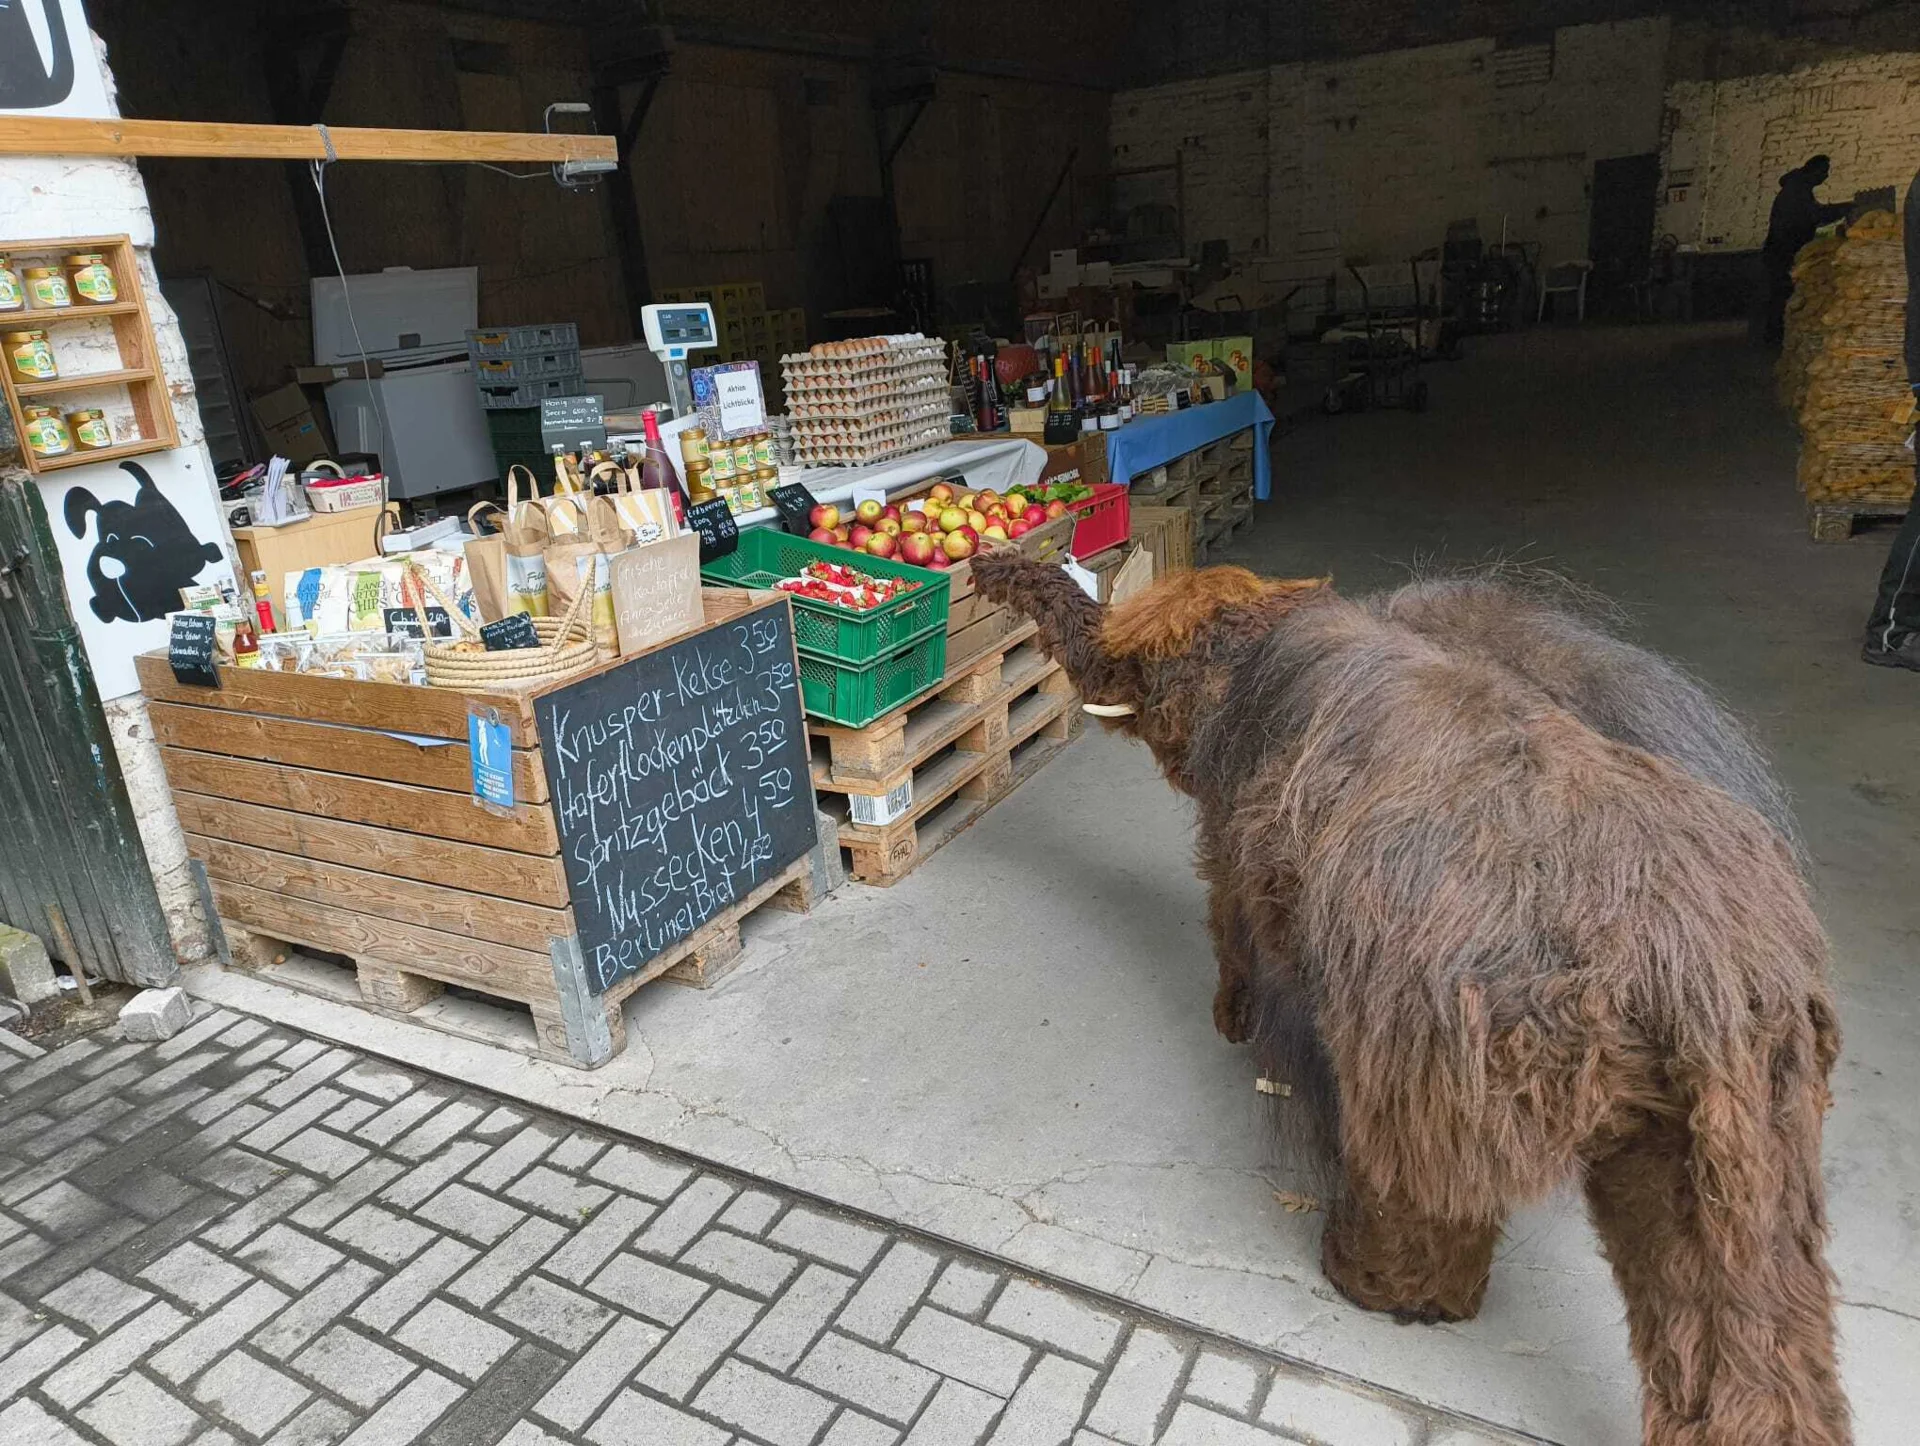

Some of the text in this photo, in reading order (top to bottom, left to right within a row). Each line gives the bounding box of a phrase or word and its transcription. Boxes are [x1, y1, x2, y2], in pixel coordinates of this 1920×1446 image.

[723, 398, 755, 409] Lichtblicke
[727, 385, 746, 393] Aktion
[553, 646, 736, 779] Knusper-Kekse
[606, 812, 743, 940] Nussecken
[596, 902, 696, 990] Berliner
